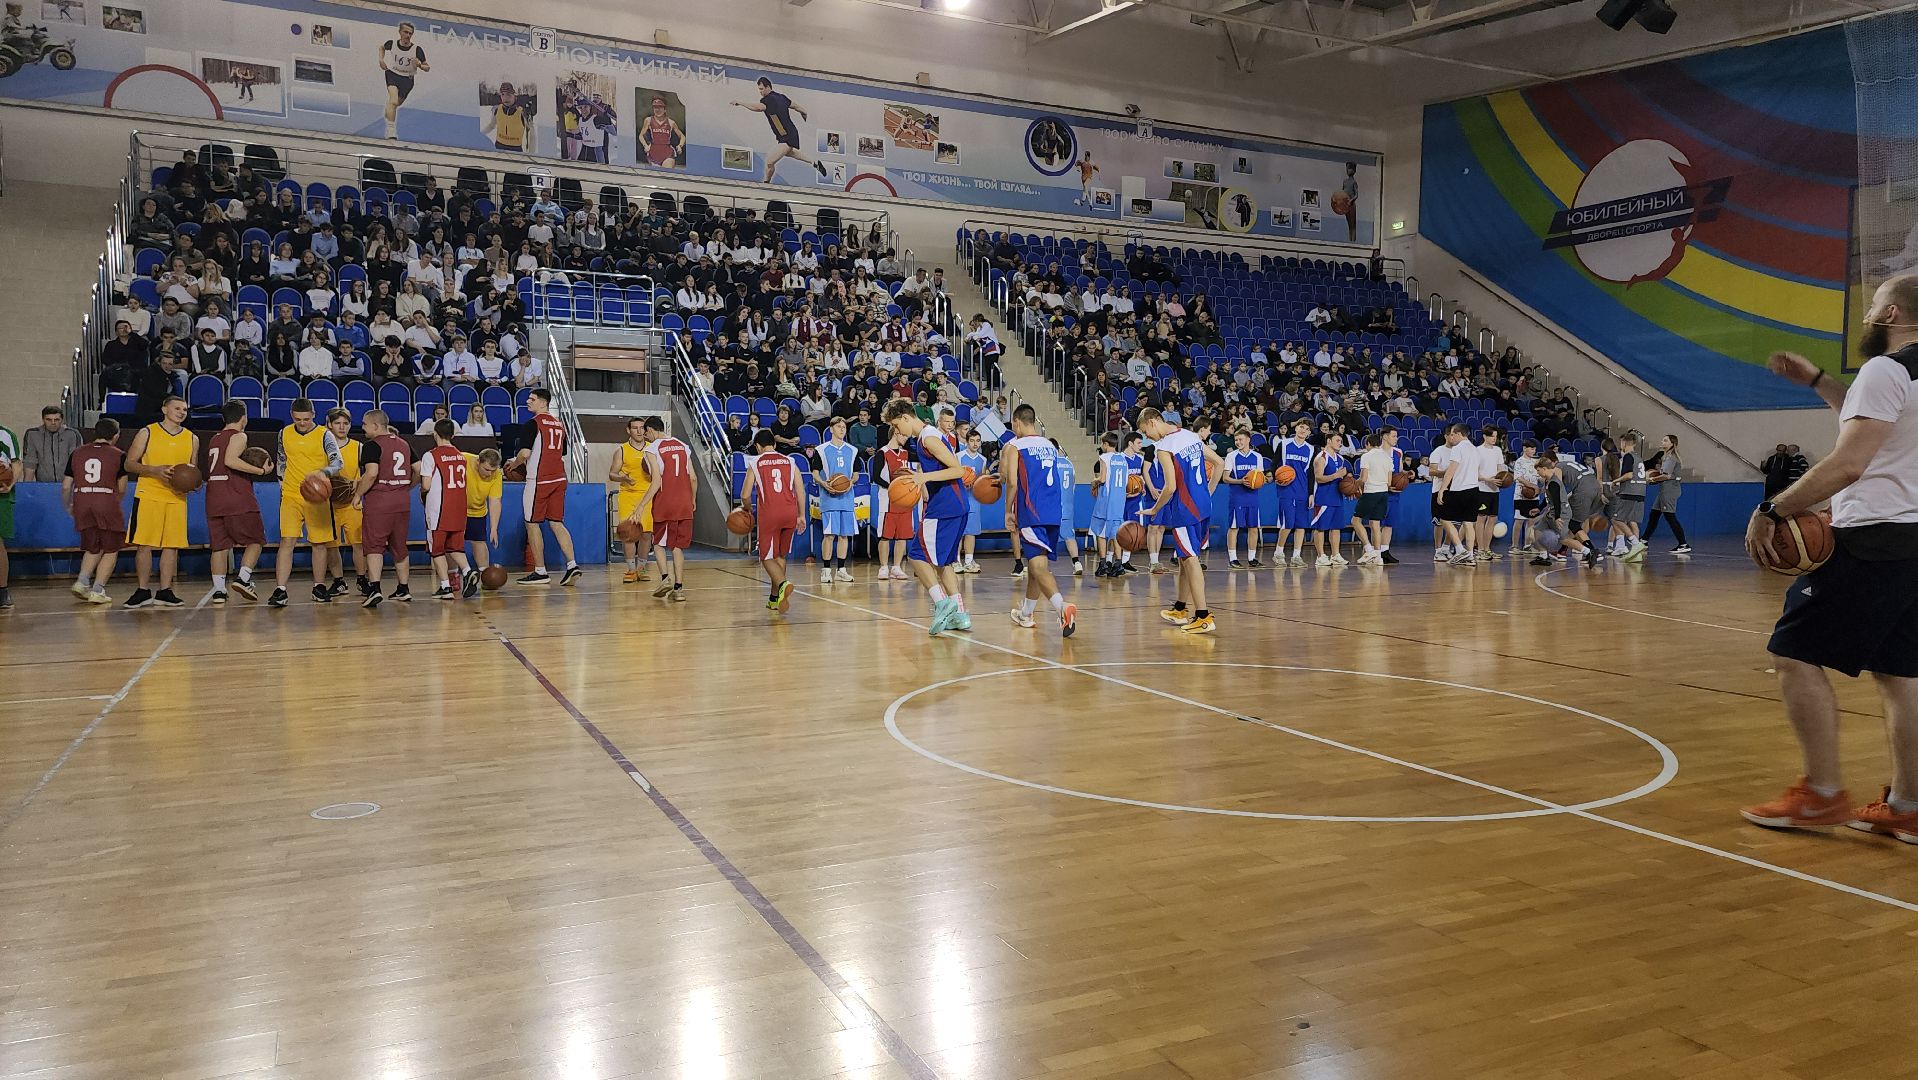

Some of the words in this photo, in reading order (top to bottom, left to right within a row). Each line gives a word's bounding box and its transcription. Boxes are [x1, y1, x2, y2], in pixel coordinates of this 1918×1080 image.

[429, 24, 543, 57] ГАЛЕРЕ
[556, 45, 726, 83] ПОБЕДИТЕЛЕЙ
[902, 172, 926, 183] ТВОЯ
[974, 178, 998, 191] ТВОЙ
[1566, 189, 1684, 226] ЮБИЛЕЙНЫЙ
[1587, 227, 1624, 242] ДВОРЕЦ
[1625, 221, 1664, 237] СПОРТА
[548, 428, 562, 449] 17
[84, 458, 102, 483] 9
[209, 447, 219, 473] 7
[392, 451, 406, 476] 2
[836, 457, 844, 468] 15
[1637, 462, 1646, 479] 3
[447, 464, 465, 489] 13
[771, 468, 782, 493] 3
[1062, 470, 1070, 489] 5
[1115, 468, 1123, 487] 11
